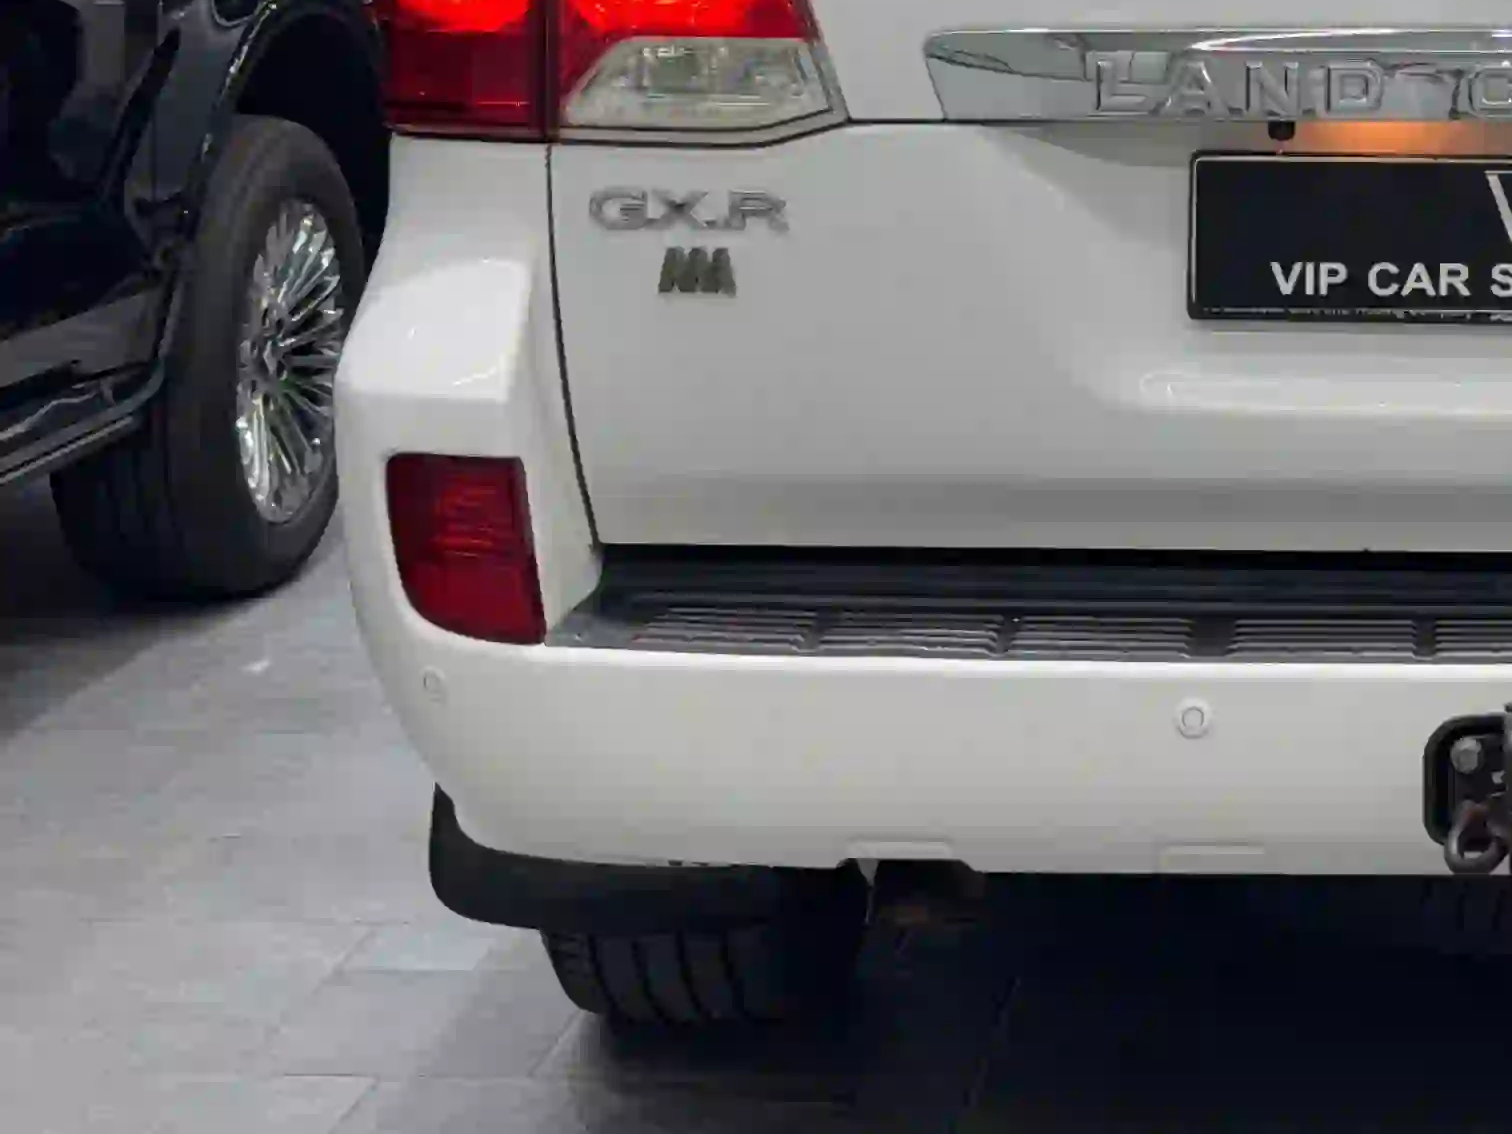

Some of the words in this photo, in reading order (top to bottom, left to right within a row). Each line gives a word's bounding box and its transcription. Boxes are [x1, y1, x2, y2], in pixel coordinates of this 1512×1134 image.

[1090, 59, 1384, 118] LAND
[1270, 261, 1348, 297] VIP
[1367, 262, 1471, 298] CAR
